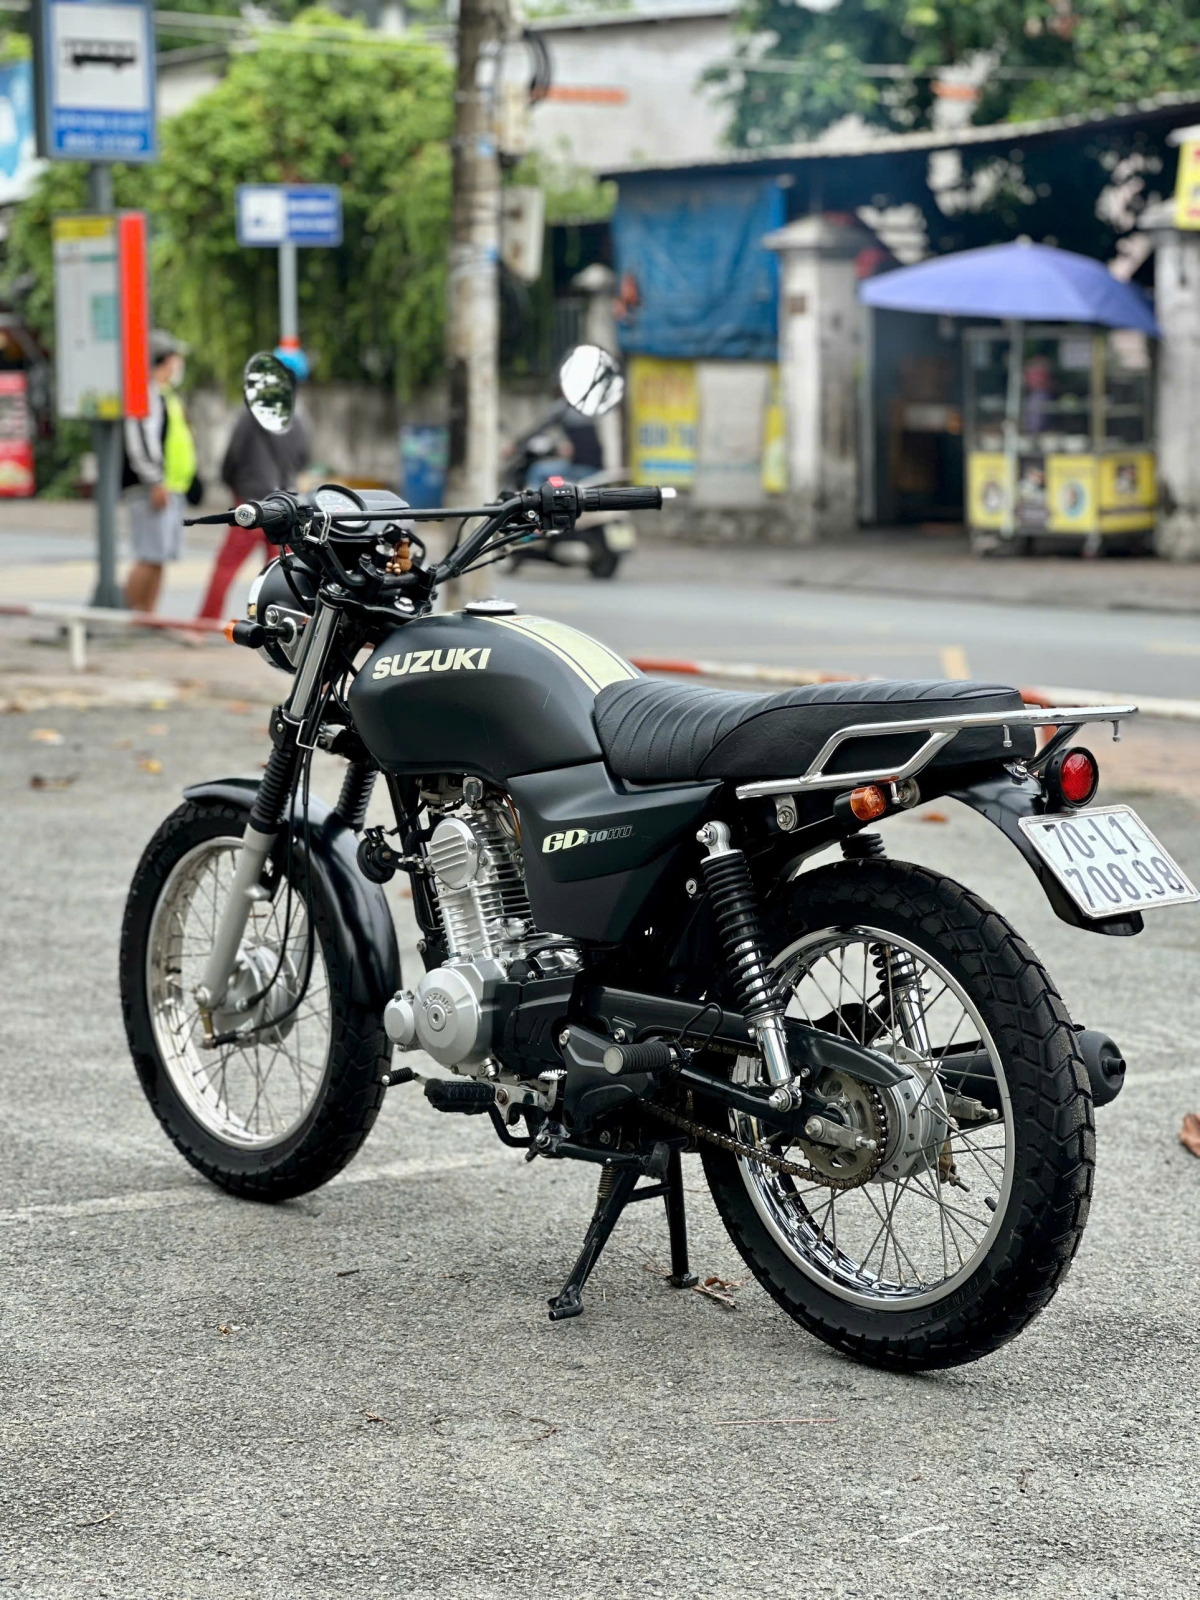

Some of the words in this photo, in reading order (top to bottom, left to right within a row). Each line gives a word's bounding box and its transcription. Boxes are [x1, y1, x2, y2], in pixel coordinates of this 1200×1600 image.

[372, 648, 491, 680] SUZUKI
[1042, 815, 1141, 862] 70-L1
[1063, 856, 1185, 908] 708.98
